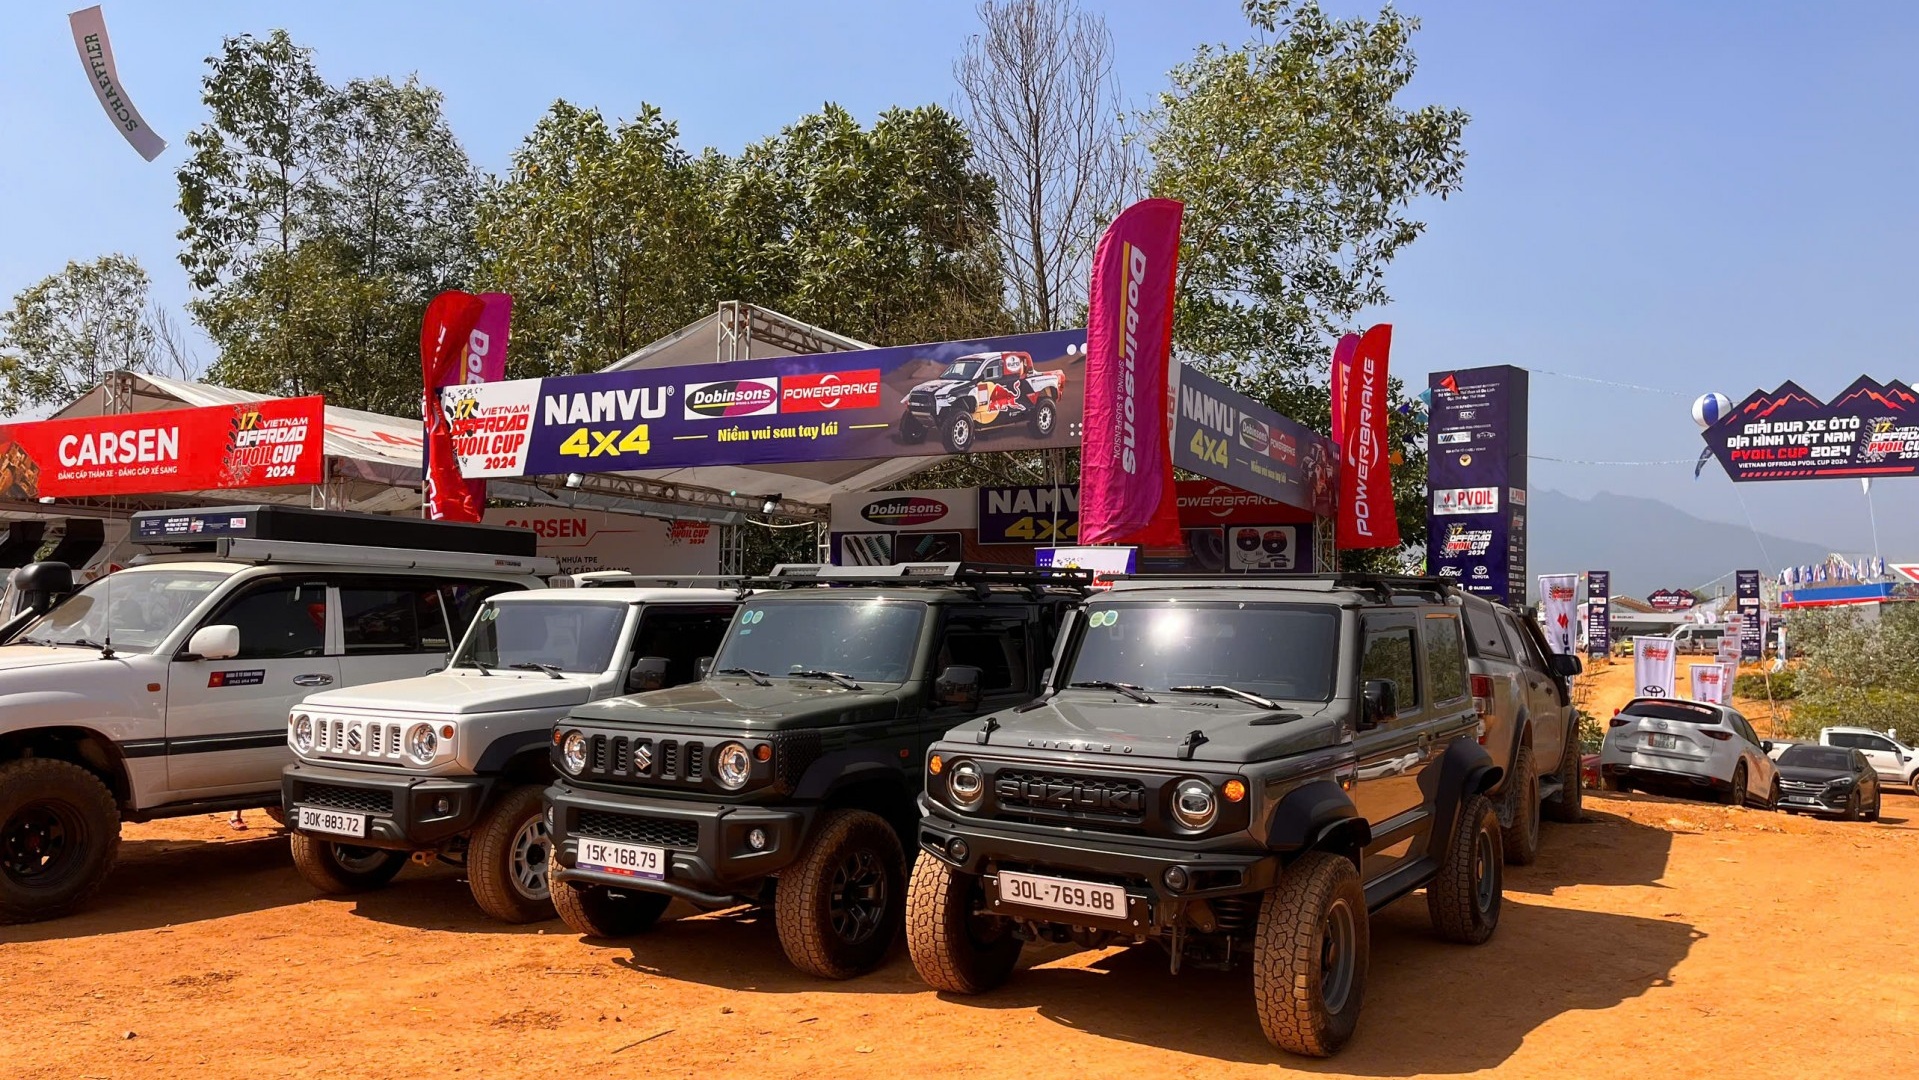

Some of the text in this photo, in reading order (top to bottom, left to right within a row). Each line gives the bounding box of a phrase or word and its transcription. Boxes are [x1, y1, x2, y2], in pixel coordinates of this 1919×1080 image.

[84, 33, 138, 132] SCHAEFFLER
[1122, 244, 1147, 475] Dobinsons
[1117, 361, 1125, 395] SPRING
[694, 389, 771, 404] Dobinsons
[783, 382, 878, 400] POWERBRAKE
[456, 398, 476, 419] 17
[481, 405, 530, 416] VIETNAM
[1182, 383, 1234, 437] NAMVU
[240, 411, 258, 430] 17
[263, 416, 308, 429] VIETNAM
[451, 414, 529, 436] OFFROAD
[1744, 415, 1860, 434] GIẢI ĐUA XE ÔTÔ
[1875, 422, 1891, 432] 17
[235, 426, 307, 447] OFFROAD
[717, 422, 838, 442] Niềm vui sau tay lái
[1113, 402, 1124, 459] SUSPENSION
[1727, 431, 1856, 449] ĐỊA HÌNH VIỆT NAM
[59, 426, 179, 467] CARSEN
[491, 433, 525, 454] CUP
[1356, 357, 1374, 537] POWERBRAKE
[1731, 445, 1851, 460] PVOIL CUP 2024
[1868, 440, 1904, 453] PVOIL
[231, 444, 303, 467] PVOIL CUP
[483, 456, 516, 469] 2024
[265, 465, 295, 478] 2024
[1457, 490, 1493, 506] PVOIL
[869, 503, 943, 515] Dobinsons
[1450, 534, 1491, 542] OFFROAD
[1452, 527, 1463, 535] 17
[1447, 541, 1490, 550] PVOIL CUP
[584, 556, 598, 564] TPE
[1439, 565, 1462, 577] Ford
[995, 779, 1140, 812] SUZUKI
[304, 811, 359, 832] 30K-883.72
[586, 843, 656, 869] 15K-168.79
[1010, 879, 1114, 910] 30L-769.88
